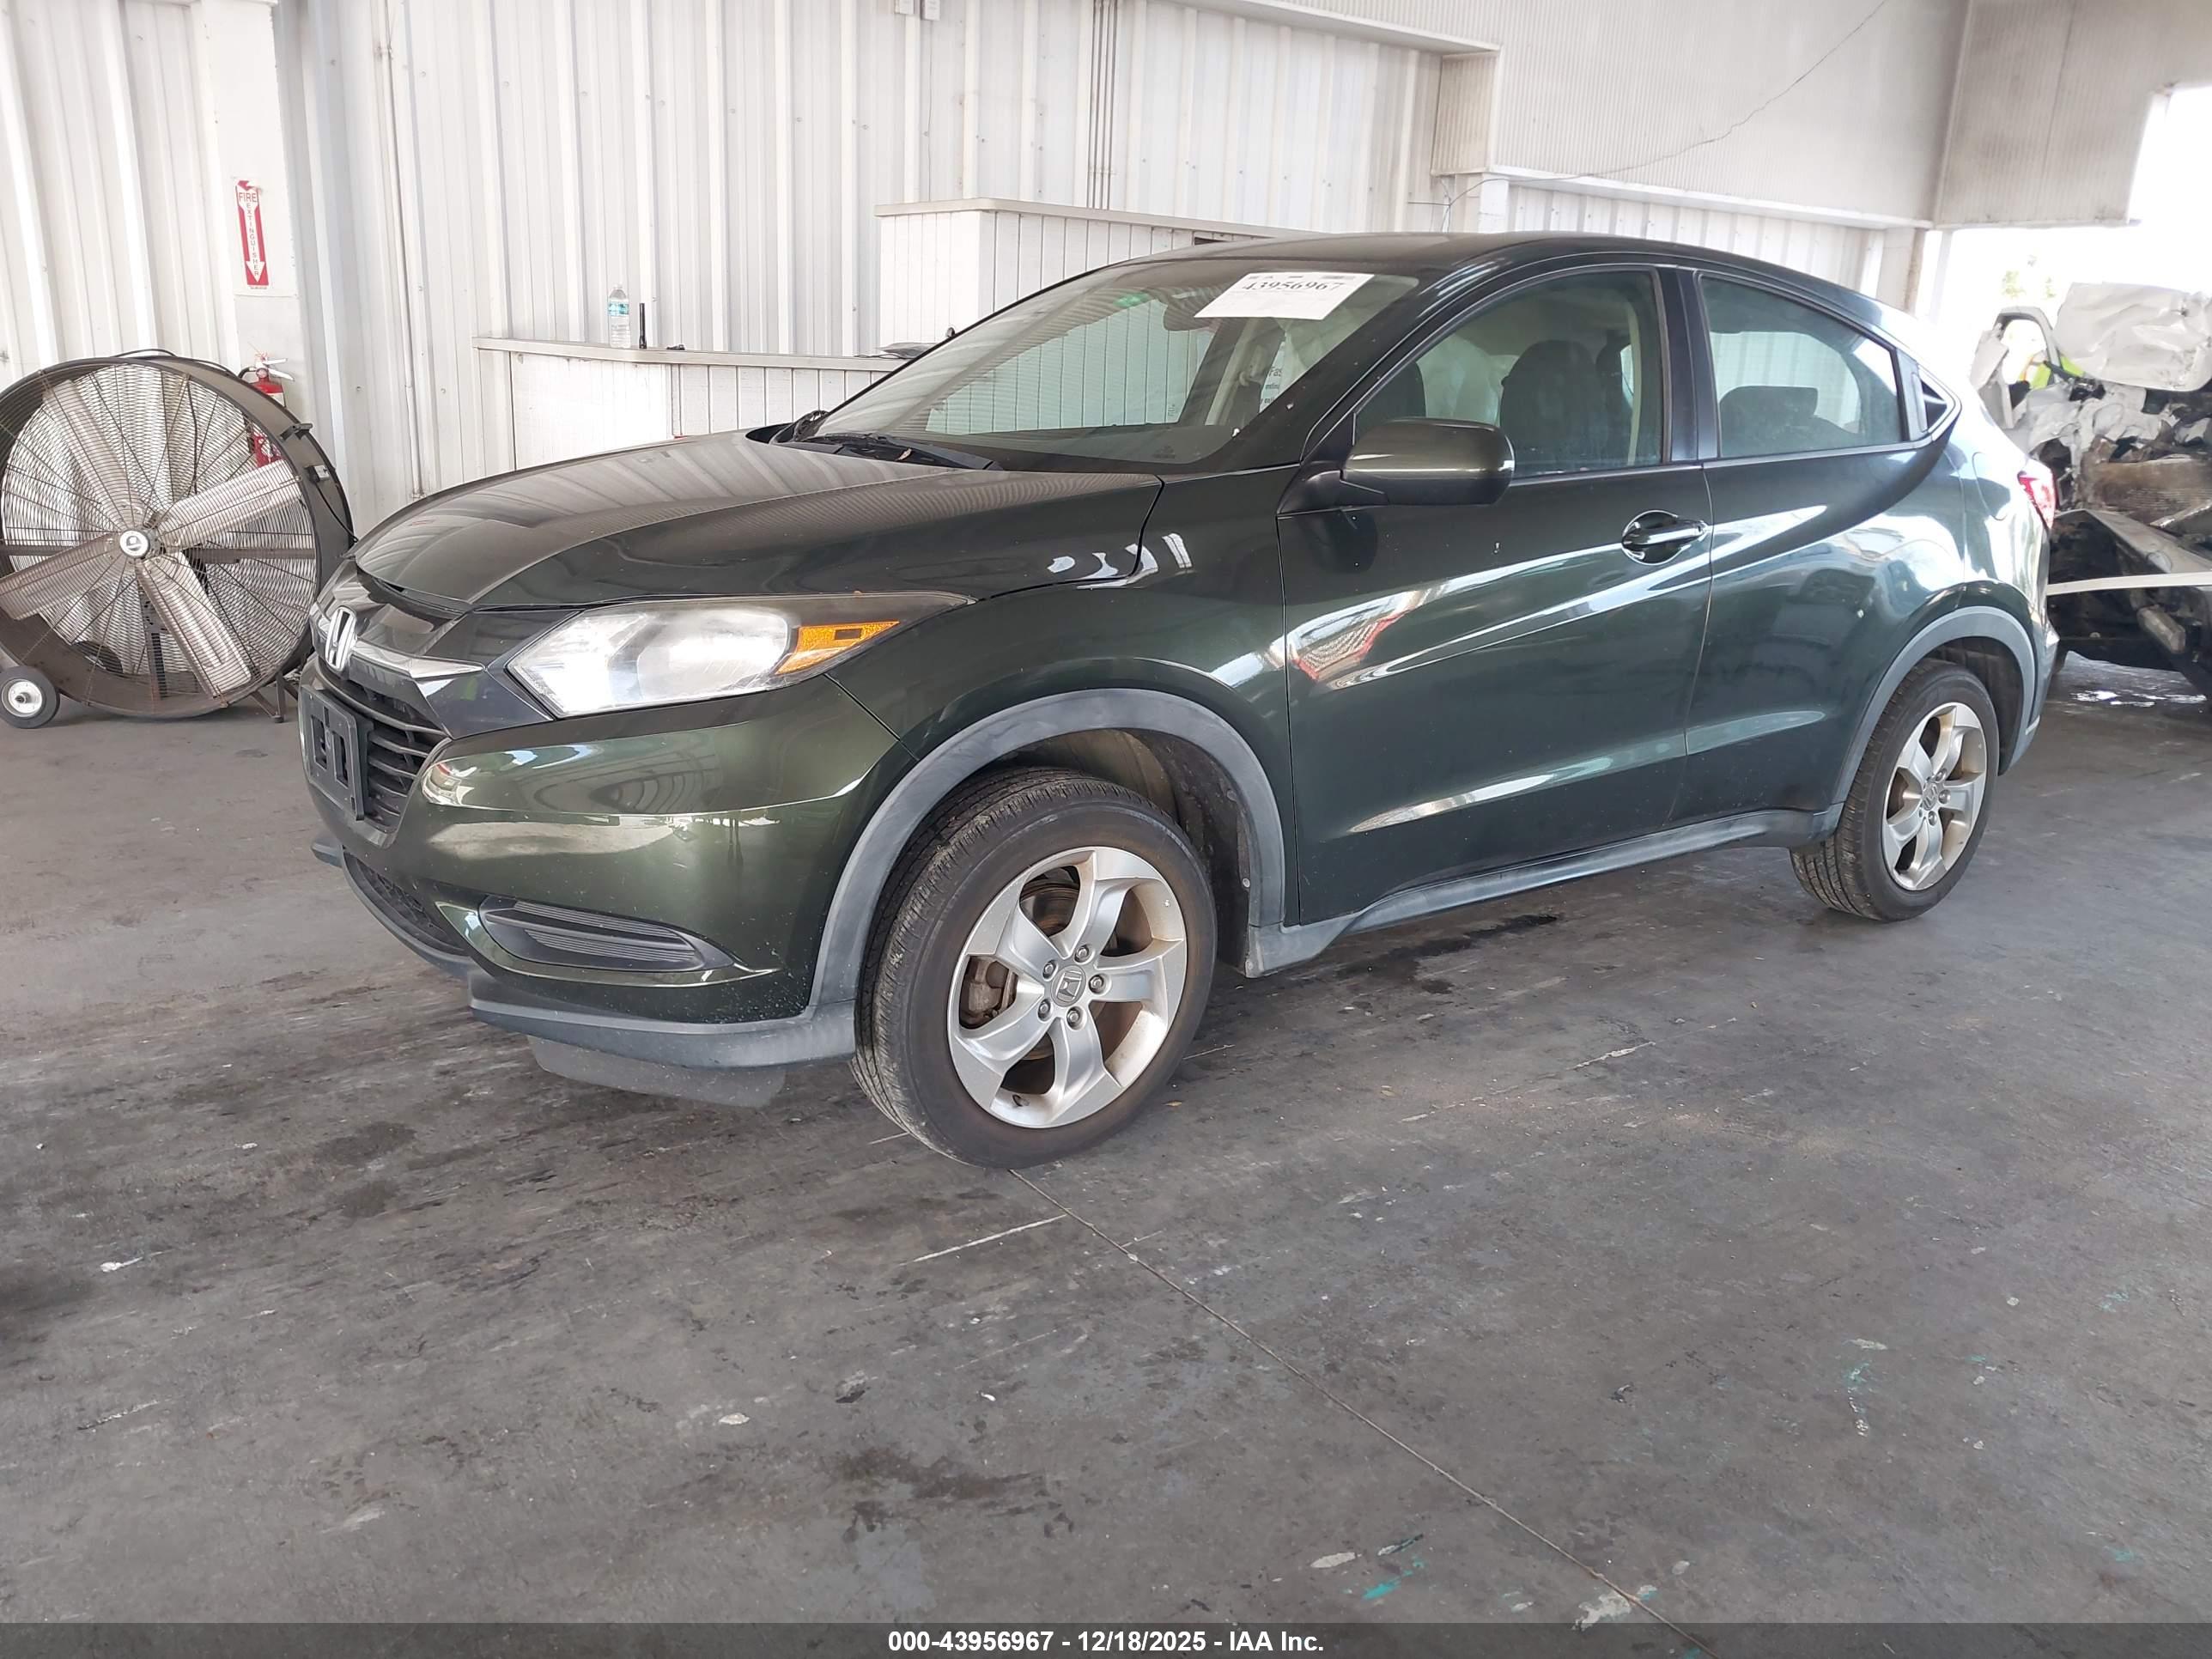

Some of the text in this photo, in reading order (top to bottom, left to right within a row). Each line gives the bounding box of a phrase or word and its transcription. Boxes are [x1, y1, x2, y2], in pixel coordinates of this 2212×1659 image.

[238, 191, 258, 203] FIRE
[246, 203, 259, 276] EXTINGUISHER
[1243, 280, 1346, 291] 43956967
